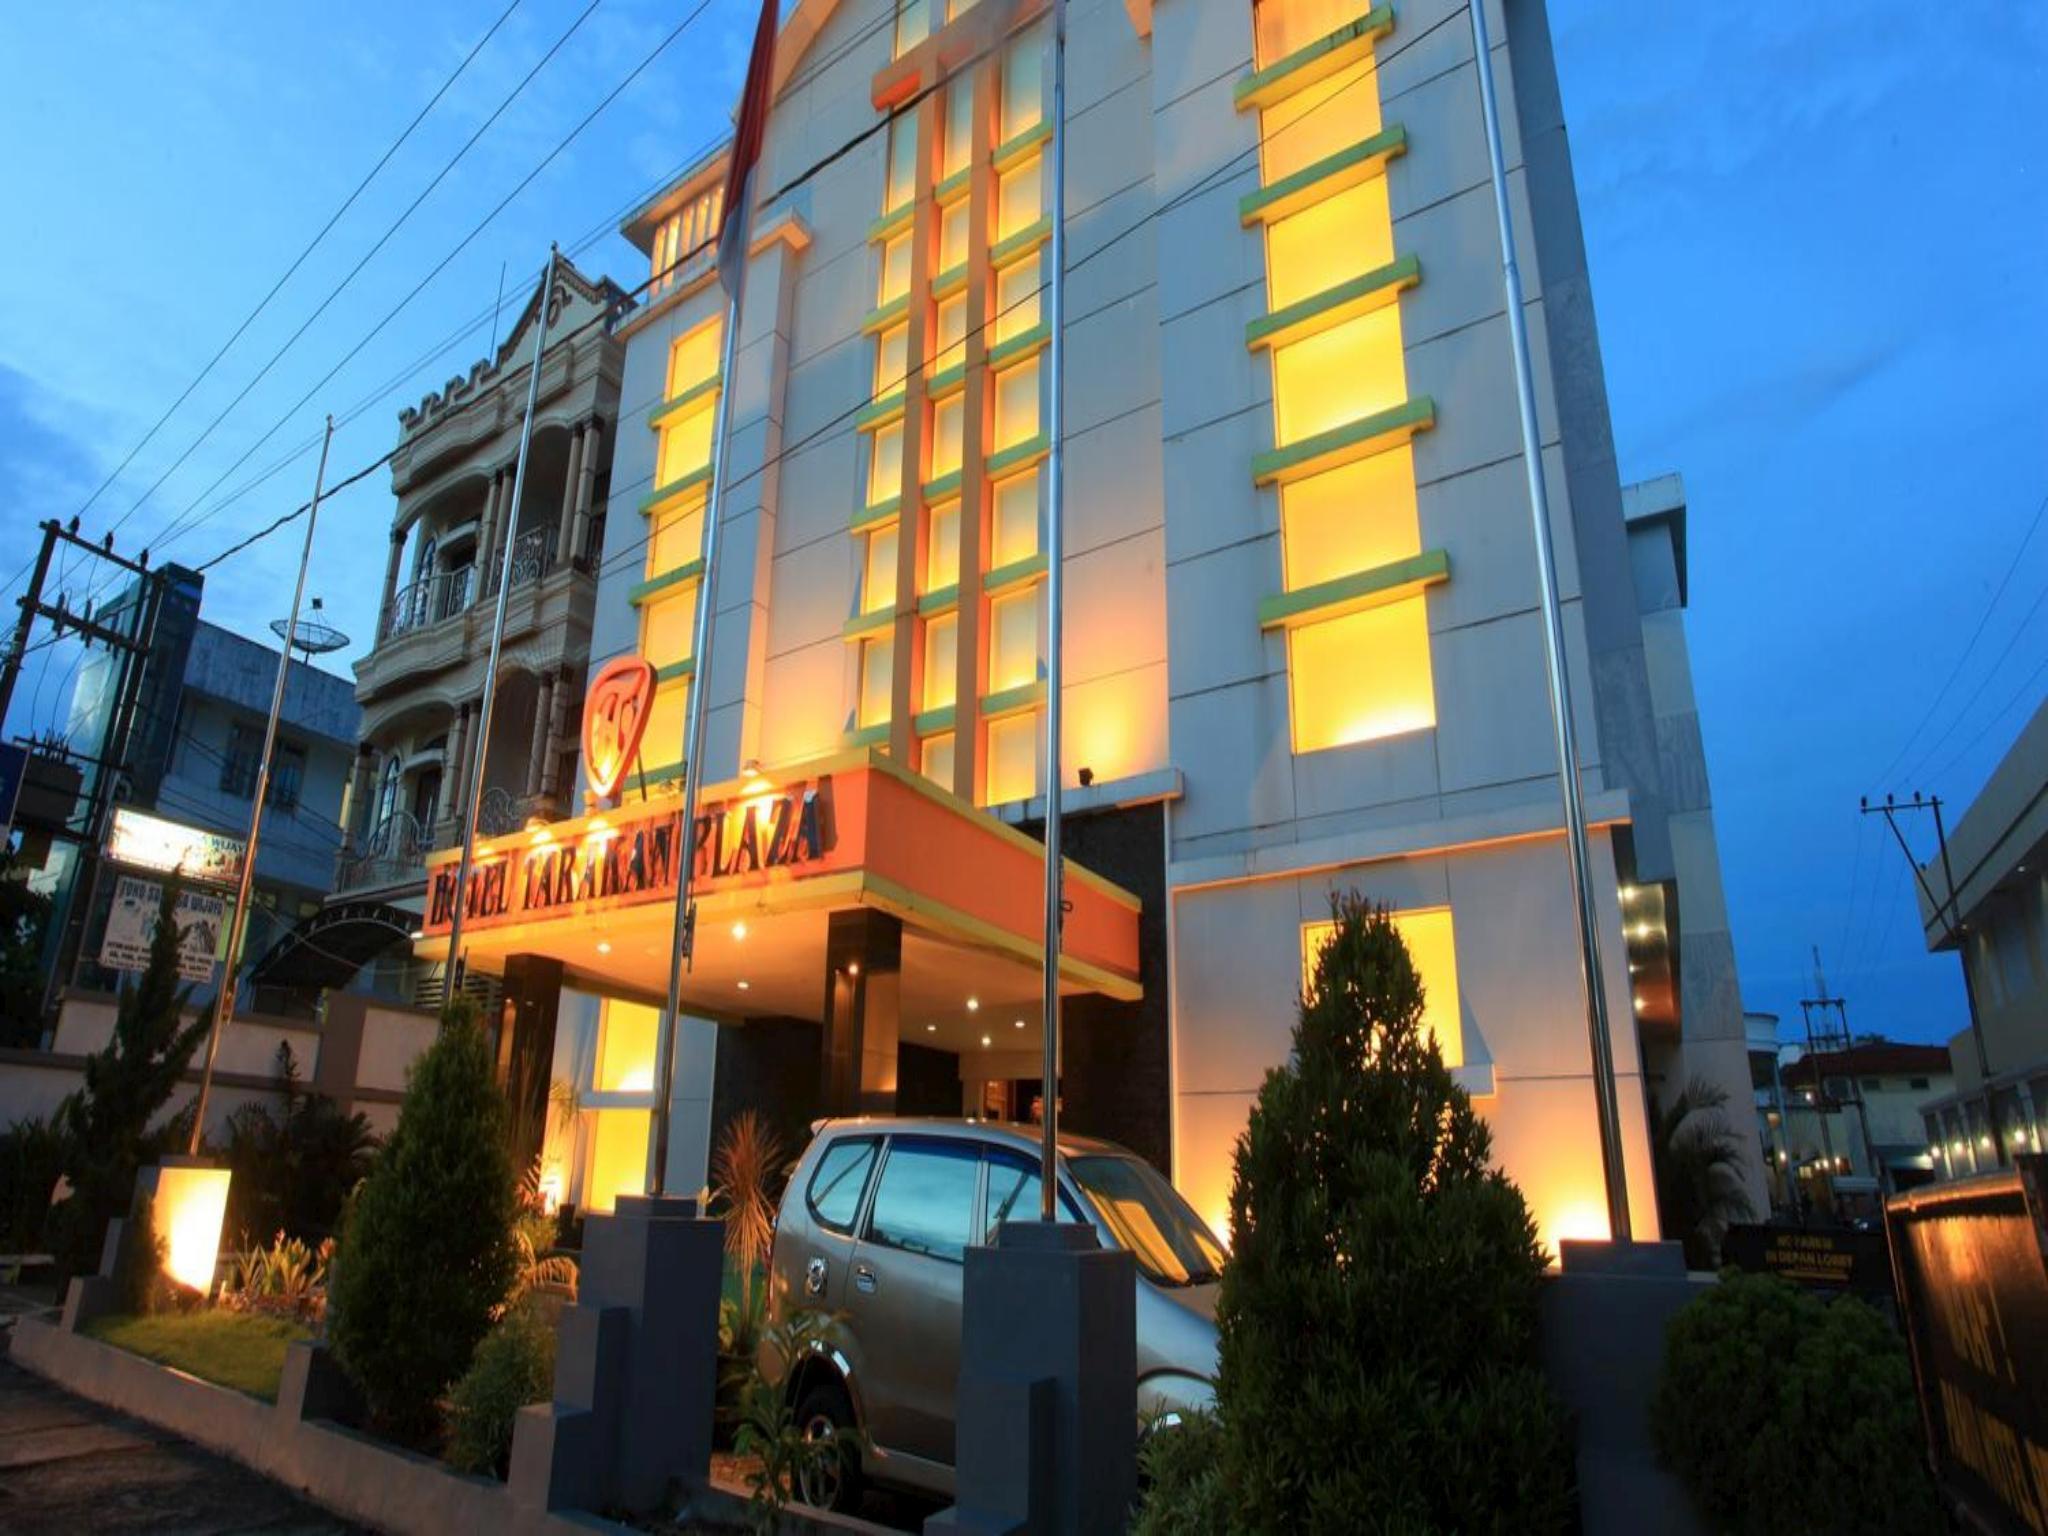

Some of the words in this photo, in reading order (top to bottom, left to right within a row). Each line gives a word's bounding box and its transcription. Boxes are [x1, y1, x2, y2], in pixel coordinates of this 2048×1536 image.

[430, 861, 509, 926] HOTEL
[522, 825, 673, 909] TARAKAN
[689, 792, 824, 880] PLAZA
